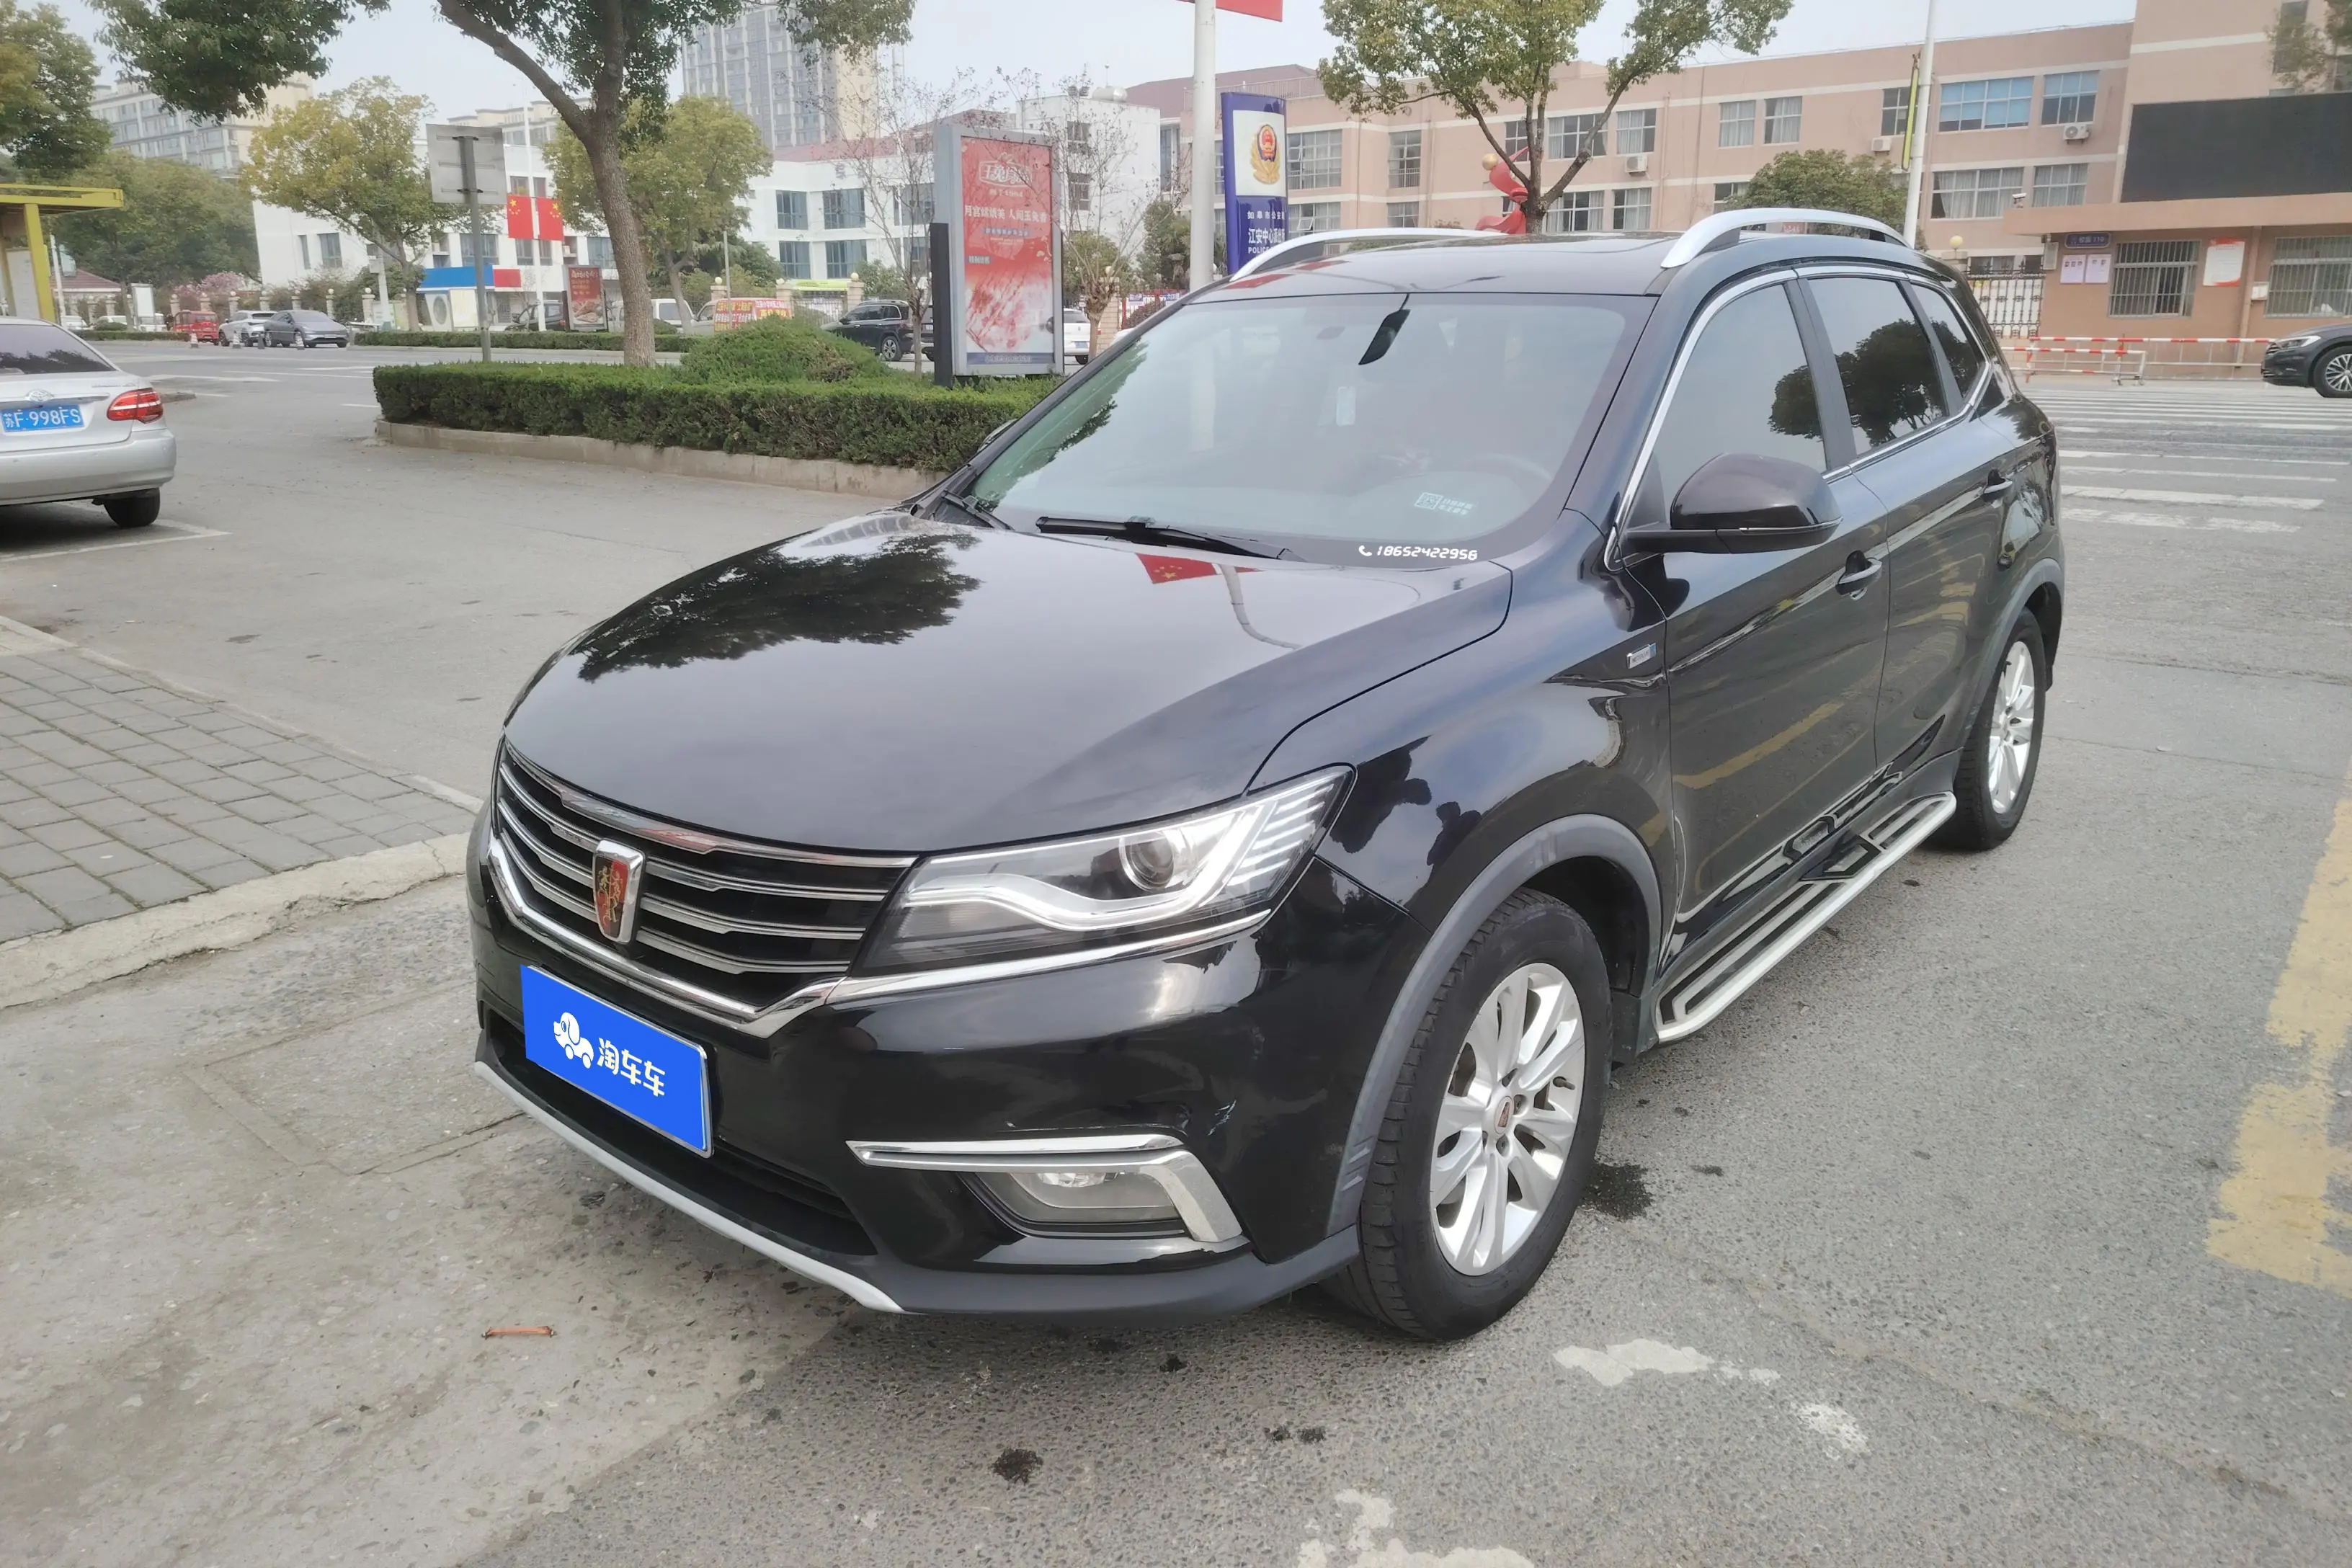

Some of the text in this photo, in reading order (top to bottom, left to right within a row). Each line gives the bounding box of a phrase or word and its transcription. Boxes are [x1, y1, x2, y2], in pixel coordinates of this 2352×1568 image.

[1248, 227, 1286, 244] 江安中心派出所
[1377, 545, 1478, 561] 18652422956
